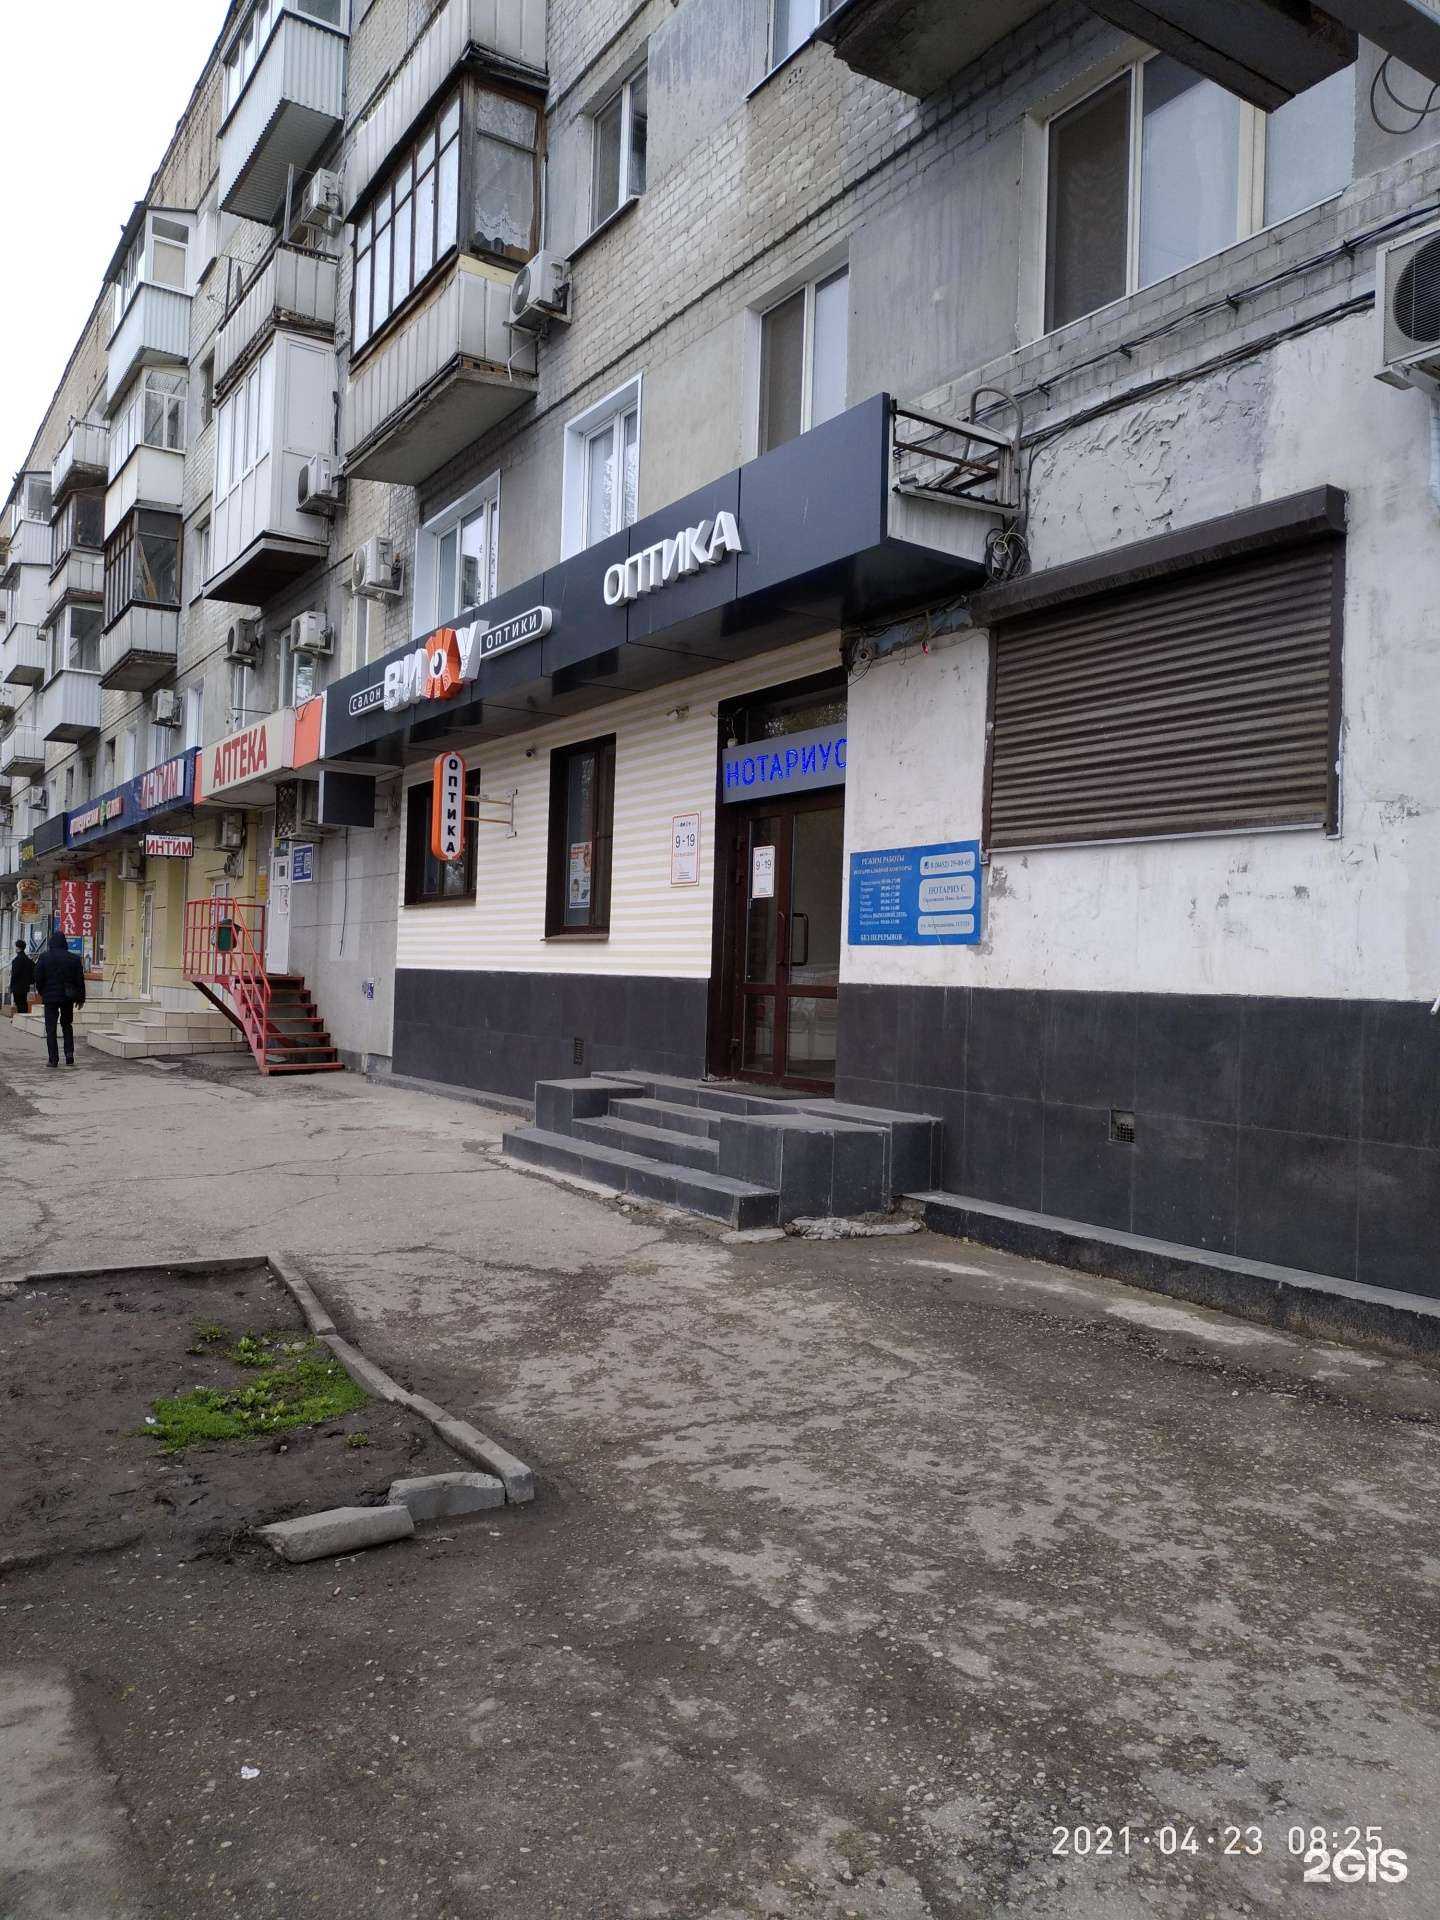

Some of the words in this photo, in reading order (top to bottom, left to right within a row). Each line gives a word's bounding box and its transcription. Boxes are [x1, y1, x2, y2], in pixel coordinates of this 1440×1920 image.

[603, 510, 742, 607] ОПТИКА
[212, 724, 268, 789] АПТЕКА
[725, 738, 848, 789] НОТАРИУС
[445, 758, 458, 853] ОПТИКА
[146, 840, 192, 856] ИНТИМ
[64, 881, 77, 935] ТАБАК
